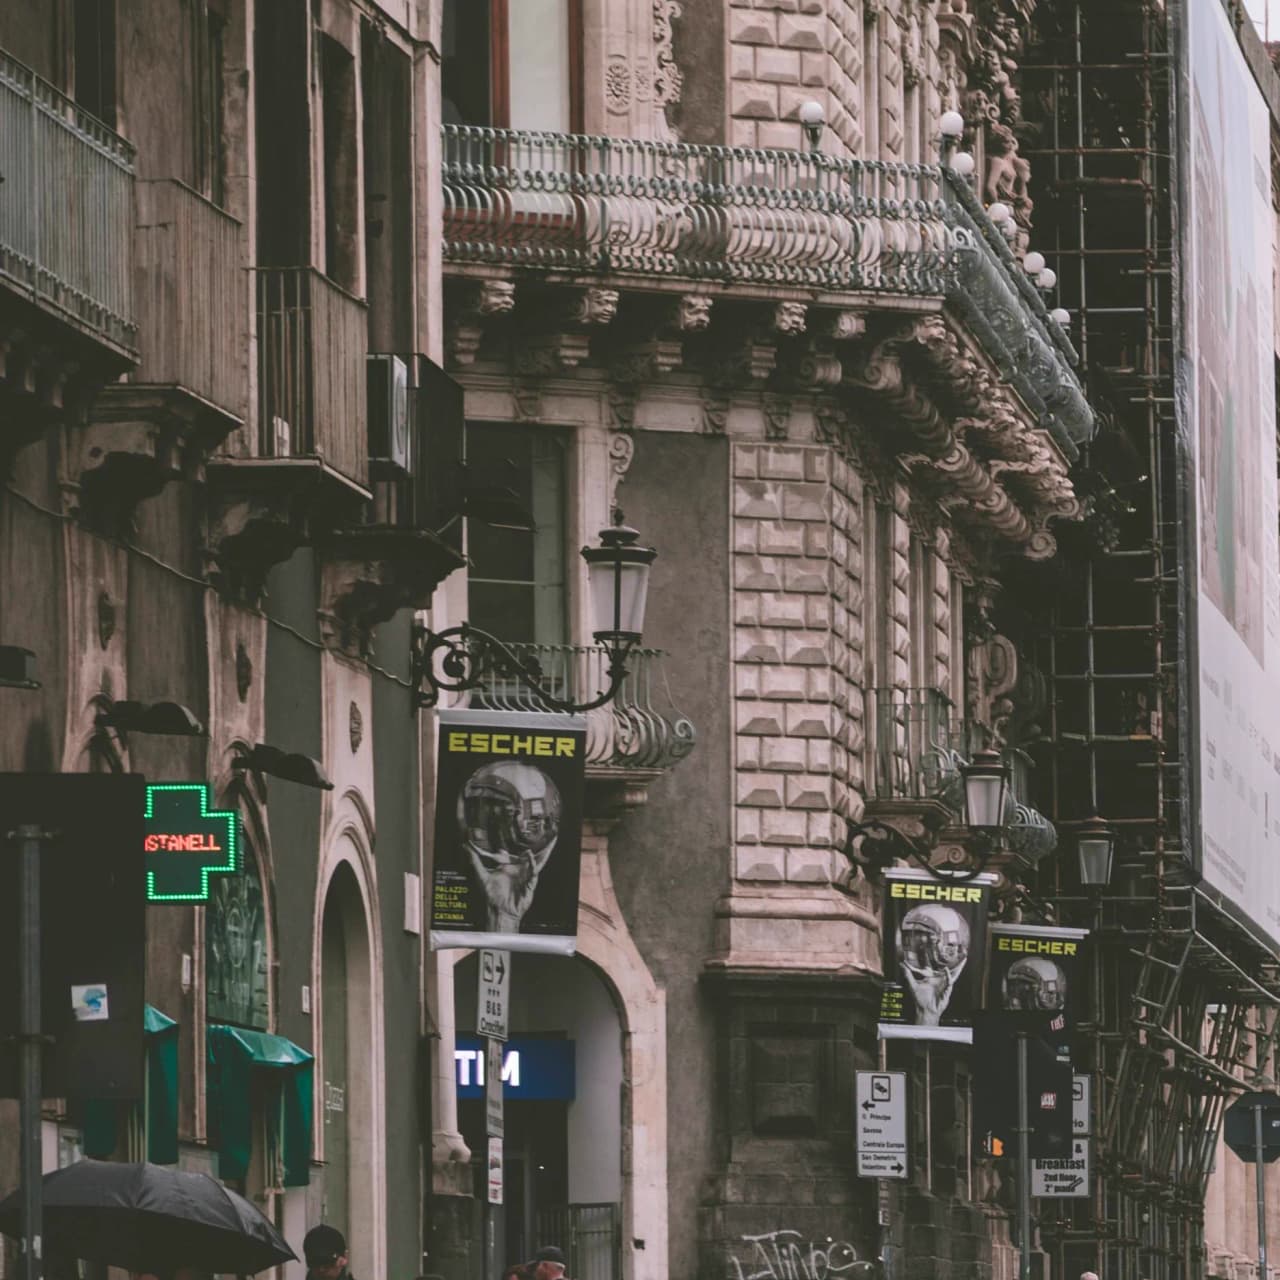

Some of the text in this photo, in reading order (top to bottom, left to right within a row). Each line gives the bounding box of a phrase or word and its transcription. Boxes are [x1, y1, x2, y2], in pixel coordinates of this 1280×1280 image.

[448, 732, 576, 757] ESCHER
[891, 883, 982, 903] ESCHER
[998, 938, 1077, 955] ESCHER
[1074, 1144, 1083, 1153] &
[1035, 1158, 1085, 1170] Breakfast
[1043, 1173, 1077, 1182] 2nd floor
